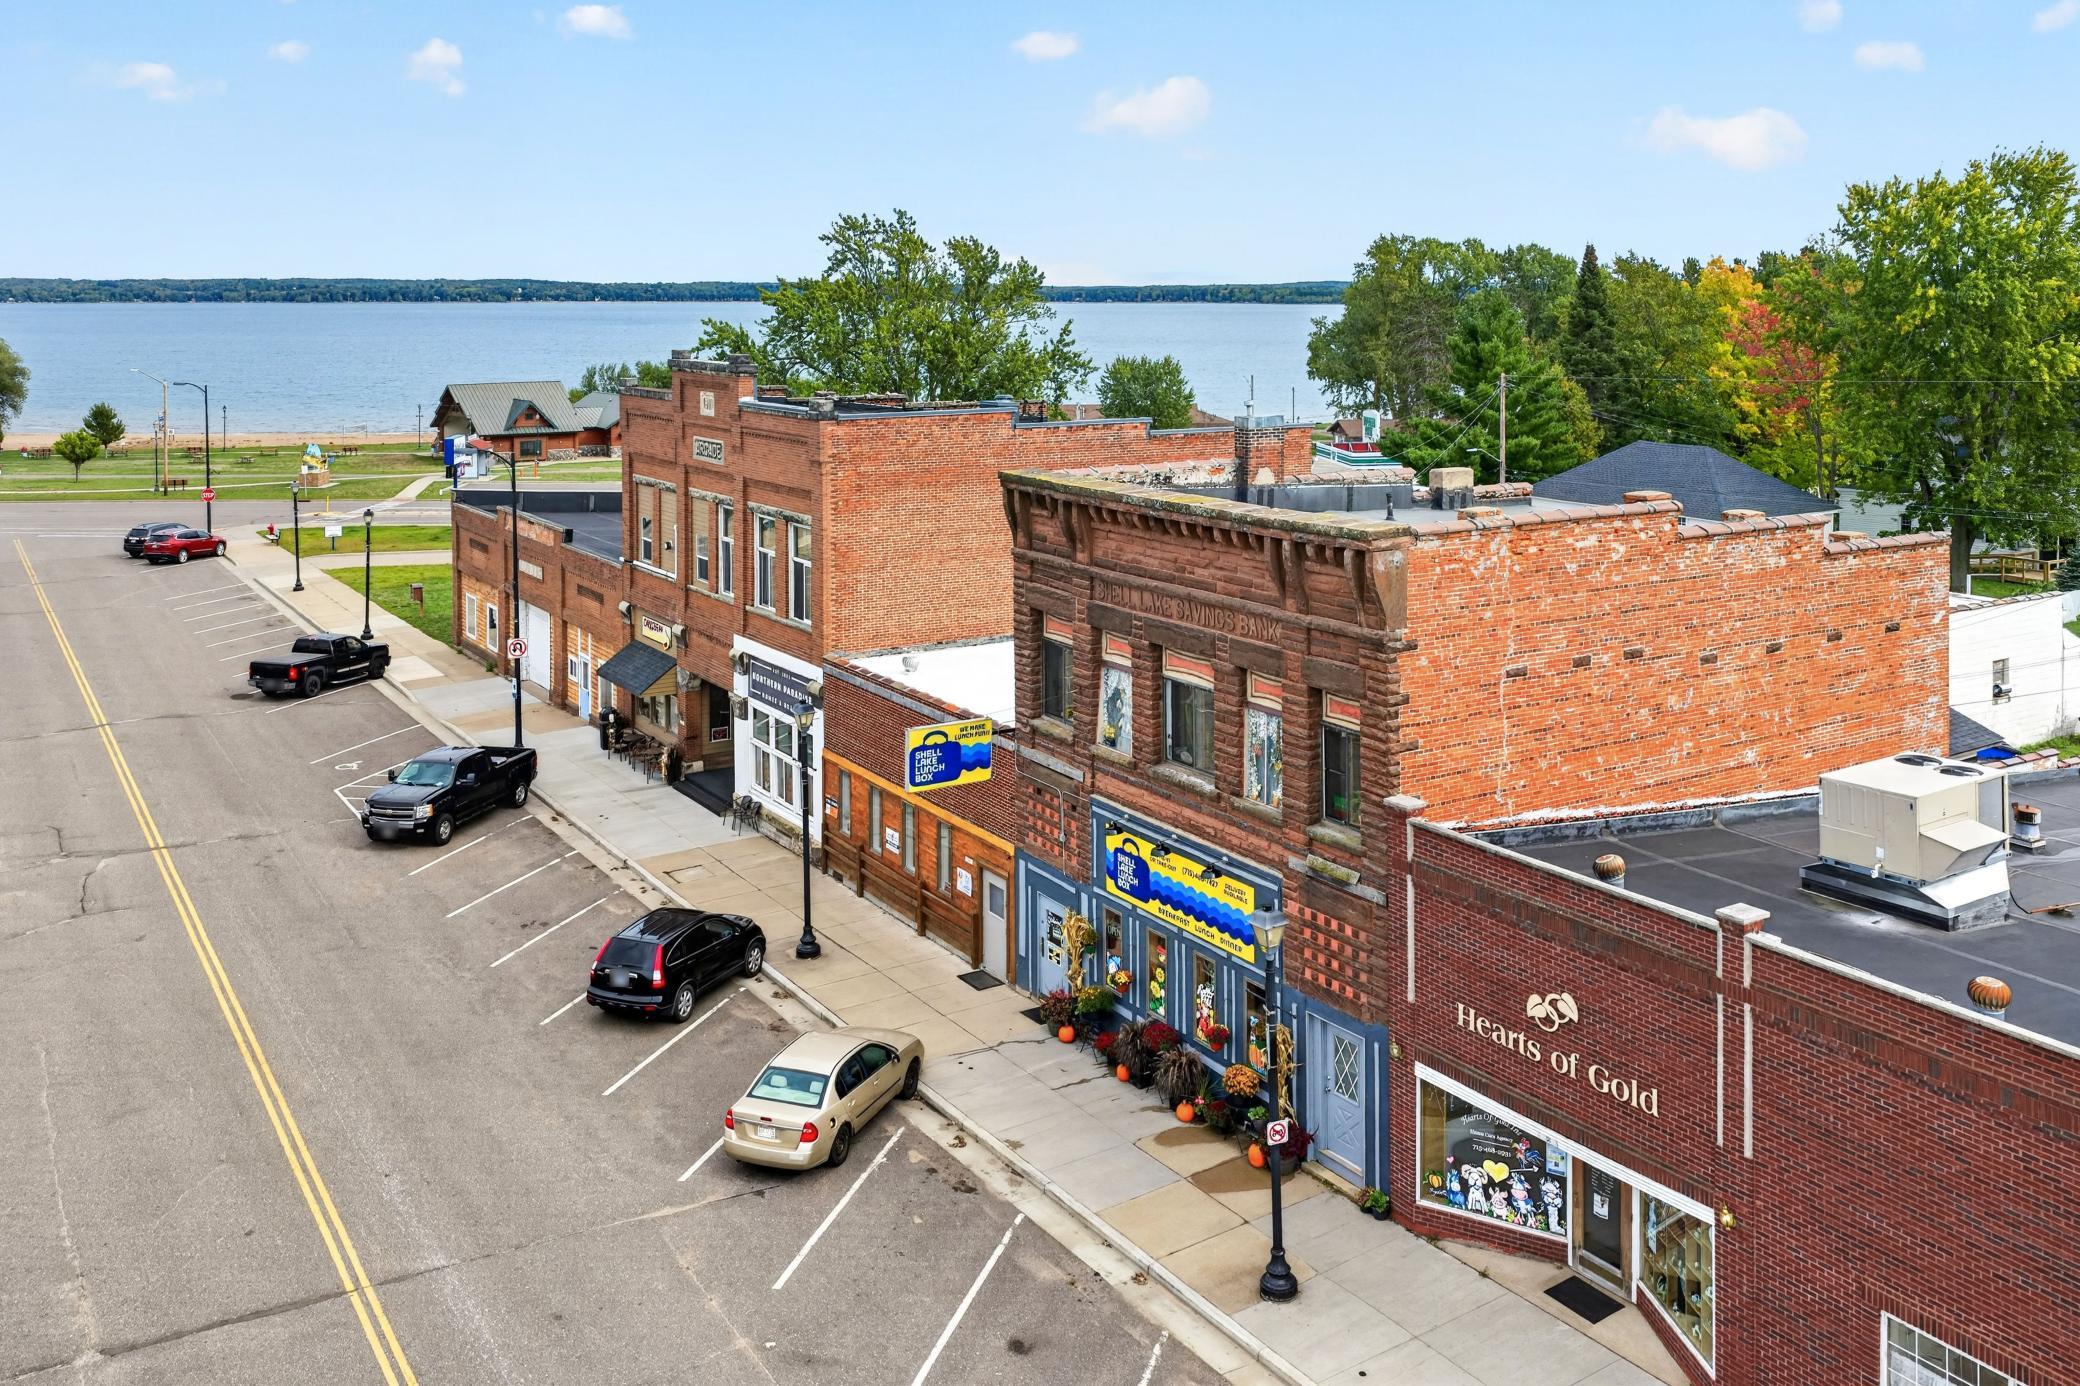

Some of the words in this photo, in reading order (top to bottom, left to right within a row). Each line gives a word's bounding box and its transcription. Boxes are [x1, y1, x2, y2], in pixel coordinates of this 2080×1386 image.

[696, 440, 722, 459] ARCADE
[1095, 582, 1133, 608] SHELL
[1137, 590, 1173, 618] LAKE
[1175, 600, 1235, 630] SAVINGS
[1239, 614, 1280, 641] BANK
[752, 671, 782, 691] NORTHERN
[783, 685, 812, 705] PARADISE
[955, 732, 974, 741] LUNCH
[915, 748, 942, 760] SHELL
[915, 757, 937, 767] LAKE
[915, 763, 945, 775] LUNCH
[915, 773, 933, 783] BOX
[1117, 852, 1136, 869] SHELL
[1117, 861, 1134, 875] LAKE
[1117, 869, 1138, 886] LUNCH
[1117, 879, 1131, 891] BOX
[1225, 883, 1247, 897] DELIVERY
[1107, 924, 1121, 937] OPEN
[1158, 907, 1190, 927] BREAKFAST
[1194, 924, 1215, 940] LUNCH
[1220, 937, 1243, 953] DINNER
[1455, 1001, 1542, 1062] Hearts
[1550, 1050, 1580, 1080] of
[1588, 1063, 1660, 1119] Gold
[1460, 1113, 1483, 1125] Hearts
